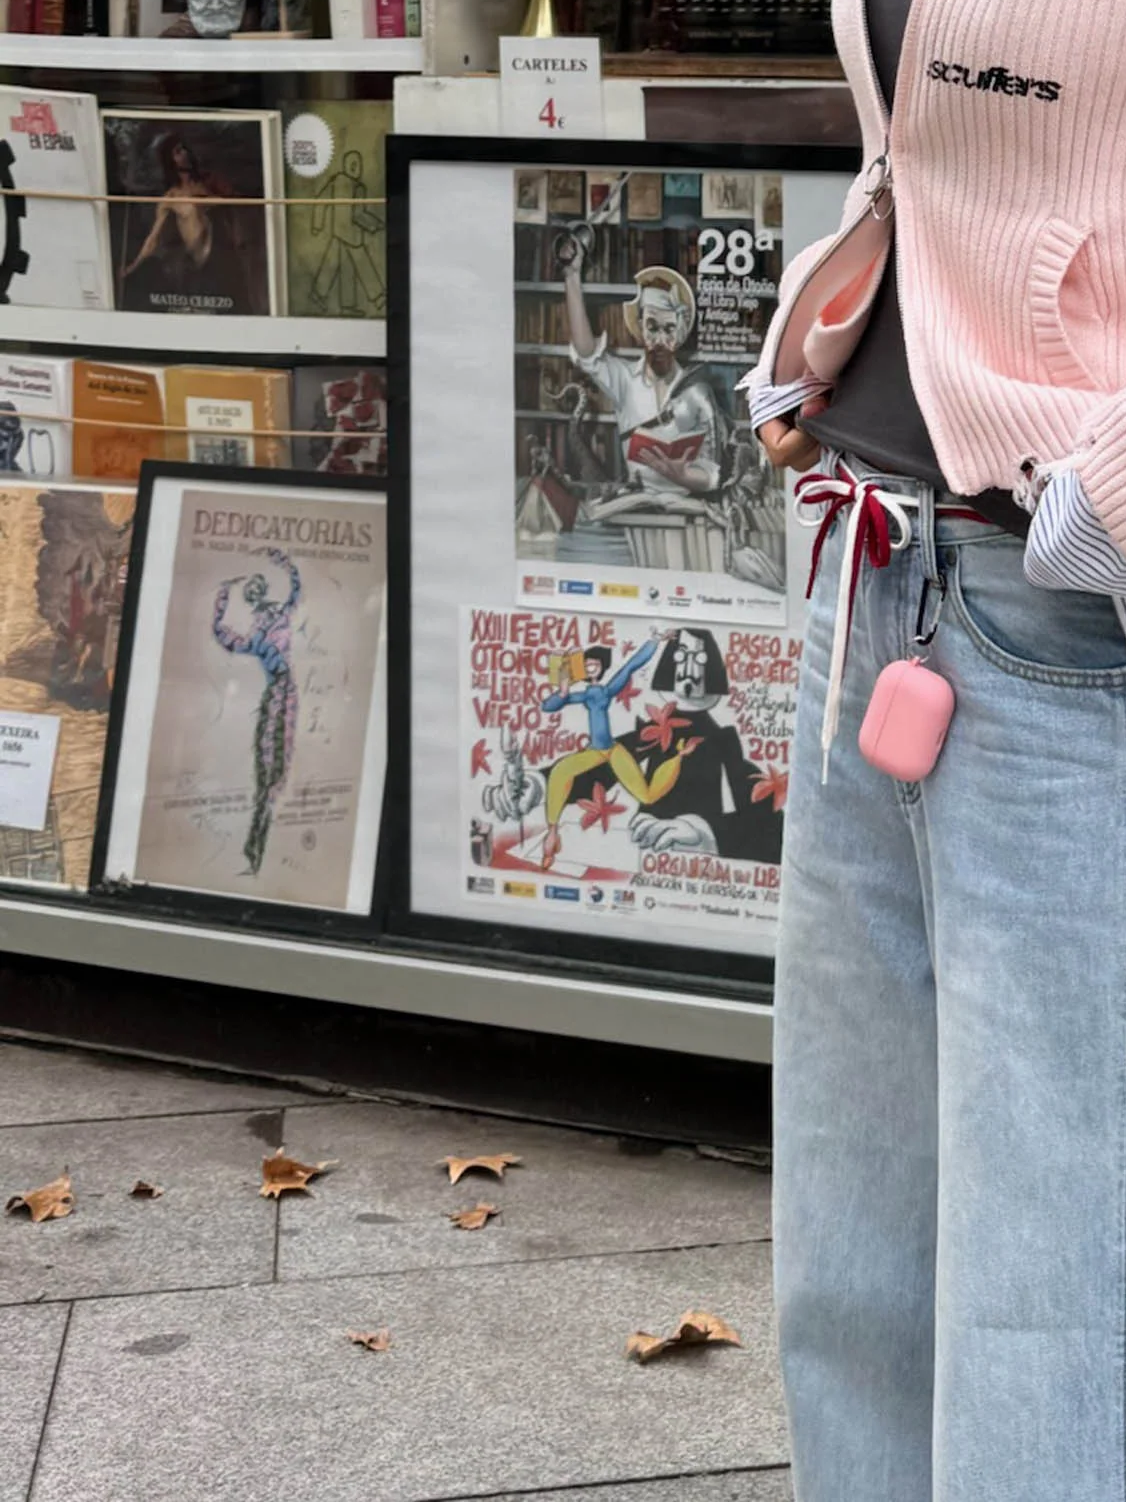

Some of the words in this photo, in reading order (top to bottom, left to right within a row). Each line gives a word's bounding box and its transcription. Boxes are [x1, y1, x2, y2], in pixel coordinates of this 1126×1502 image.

[511, 57, 588, 72] CARTELES
[193, 509, 373, 548] DEDICATORIAS
[470, 609, 507, 642] XXIII
[510, 613, 582, 647] FERIA
[588, 618, 616, 646] DE
[471, 643, 550, 676] OTOÑO
[729, 632, 781, 660] PASEO
[725, 652, 800, 685] RECOLETO
[491, 671, 554, 705] LIBRO
[472, 696, 541, 731] VIEJO
